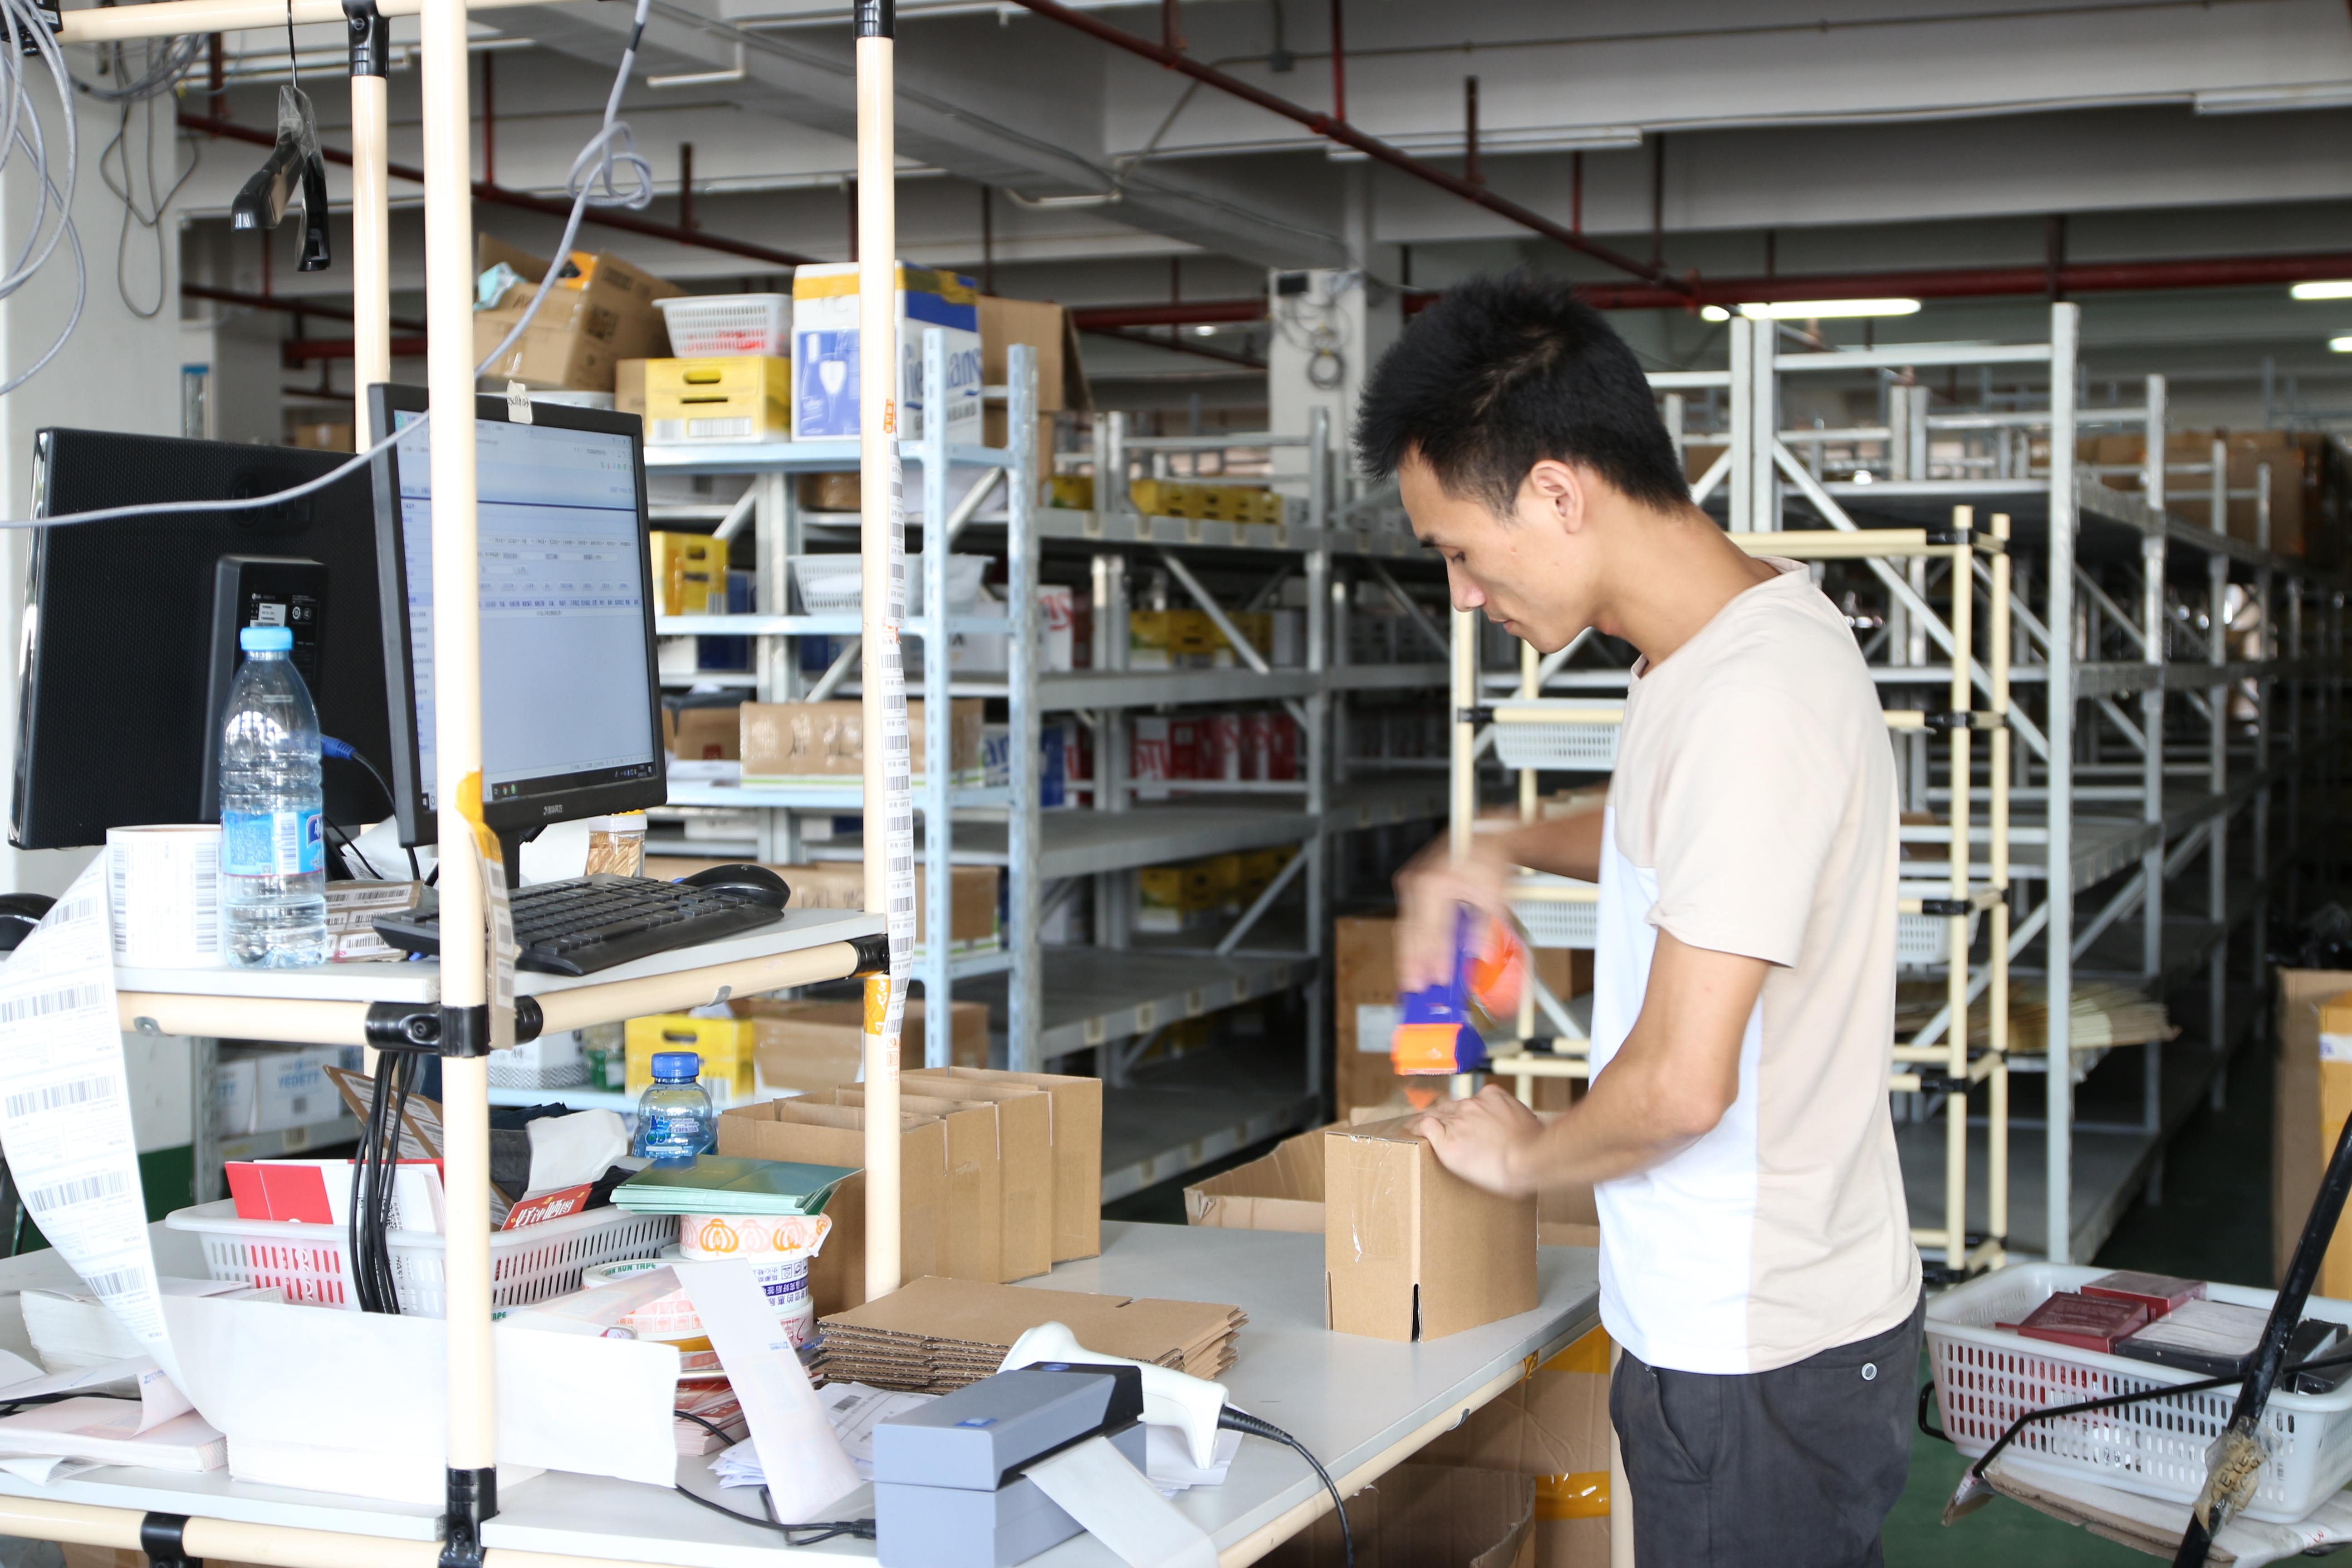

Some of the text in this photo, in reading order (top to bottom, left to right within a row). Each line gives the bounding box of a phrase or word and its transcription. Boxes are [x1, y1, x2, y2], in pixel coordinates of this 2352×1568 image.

[165, 906, 171, 914] TO
[278, 1070, 319, 1089] VEDETT
[108, 1138, 126, 1146] FROM
[513, 1198, 575, 1229] 好评晒图
[123, 1235, 141, 1243] FROM
[617, 1264, 632, 1273] KUN
[143, 1372, 157, 1384] ZTO
